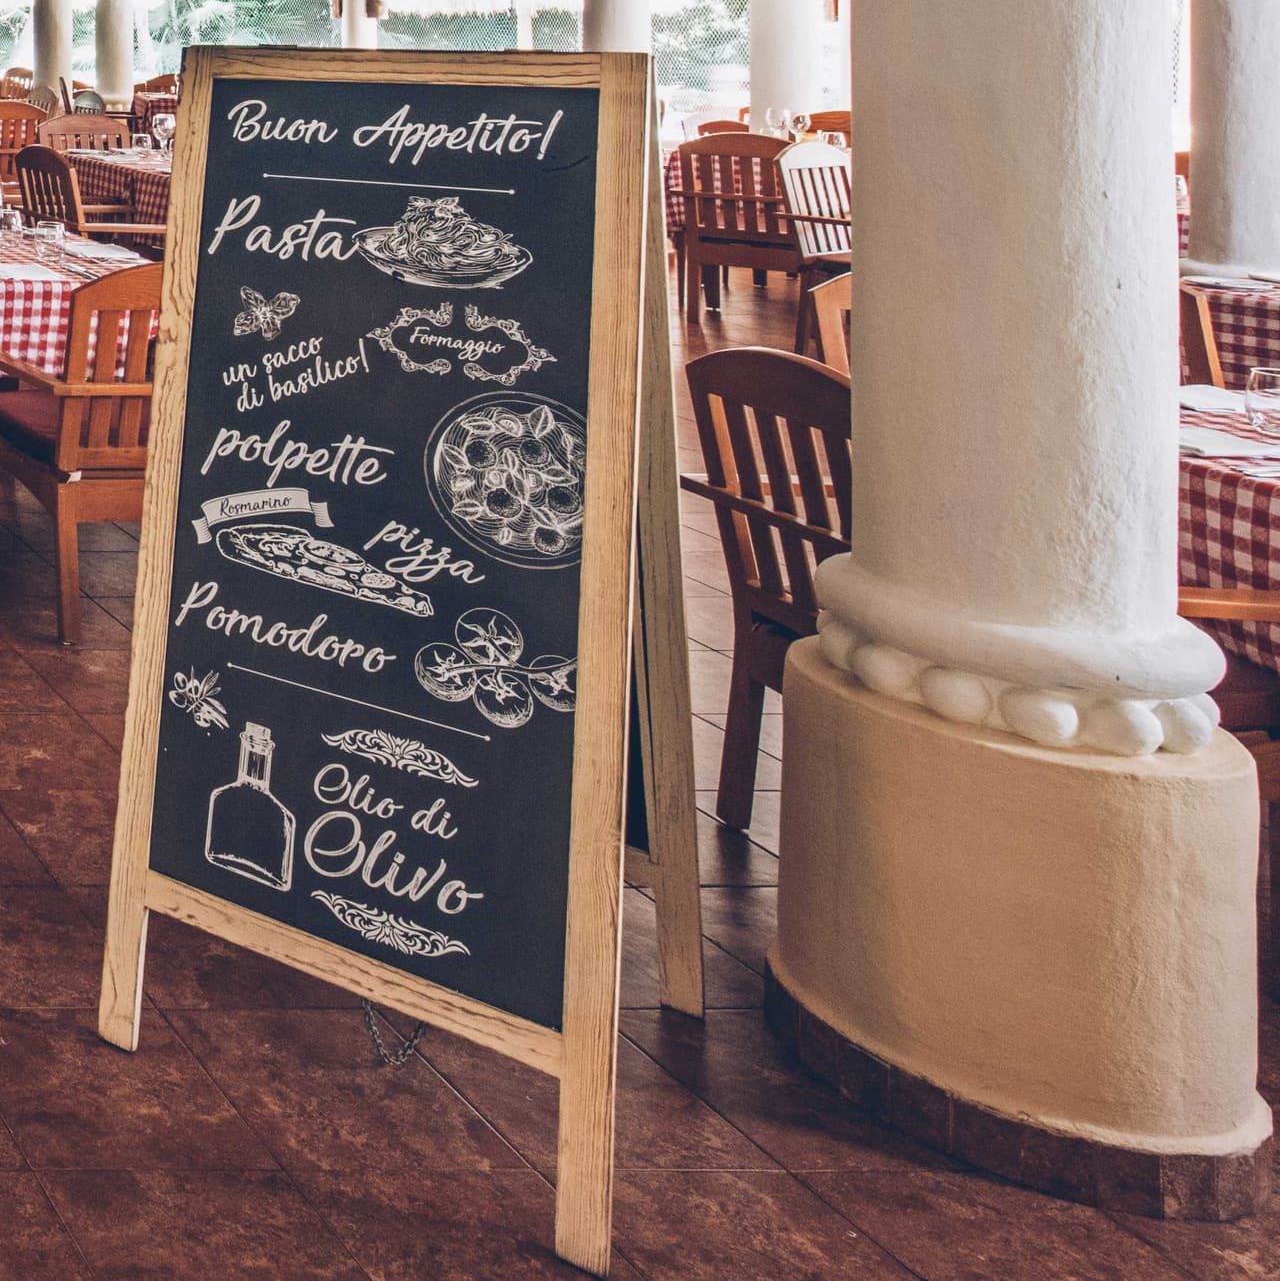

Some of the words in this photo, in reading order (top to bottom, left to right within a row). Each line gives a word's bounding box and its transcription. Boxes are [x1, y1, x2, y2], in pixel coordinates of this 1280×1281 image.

[227, 99, 338, 143] Buon
[353, 104, 563, 165] Appetito!
[208, 195, 358, 261] Pasta
[222, 361, 257, 387] un
[263, 336, 323, 372] sacco
[237, 380, 263, 413] di
[269, 338, 371, 404] basilico!
[409, 325, 505, 362] Formaggio
[201, 420, 394, 487] polpette
[220, 497, 292, 517] Rosmarino
[363, 519, 485, 585] pizza
[175, 581, 396, 674] Pomodoro
[313, 763, 404, 819] Olio
[411, 798, 458, 839] di
[304, 811, 483, 914] Olivo
